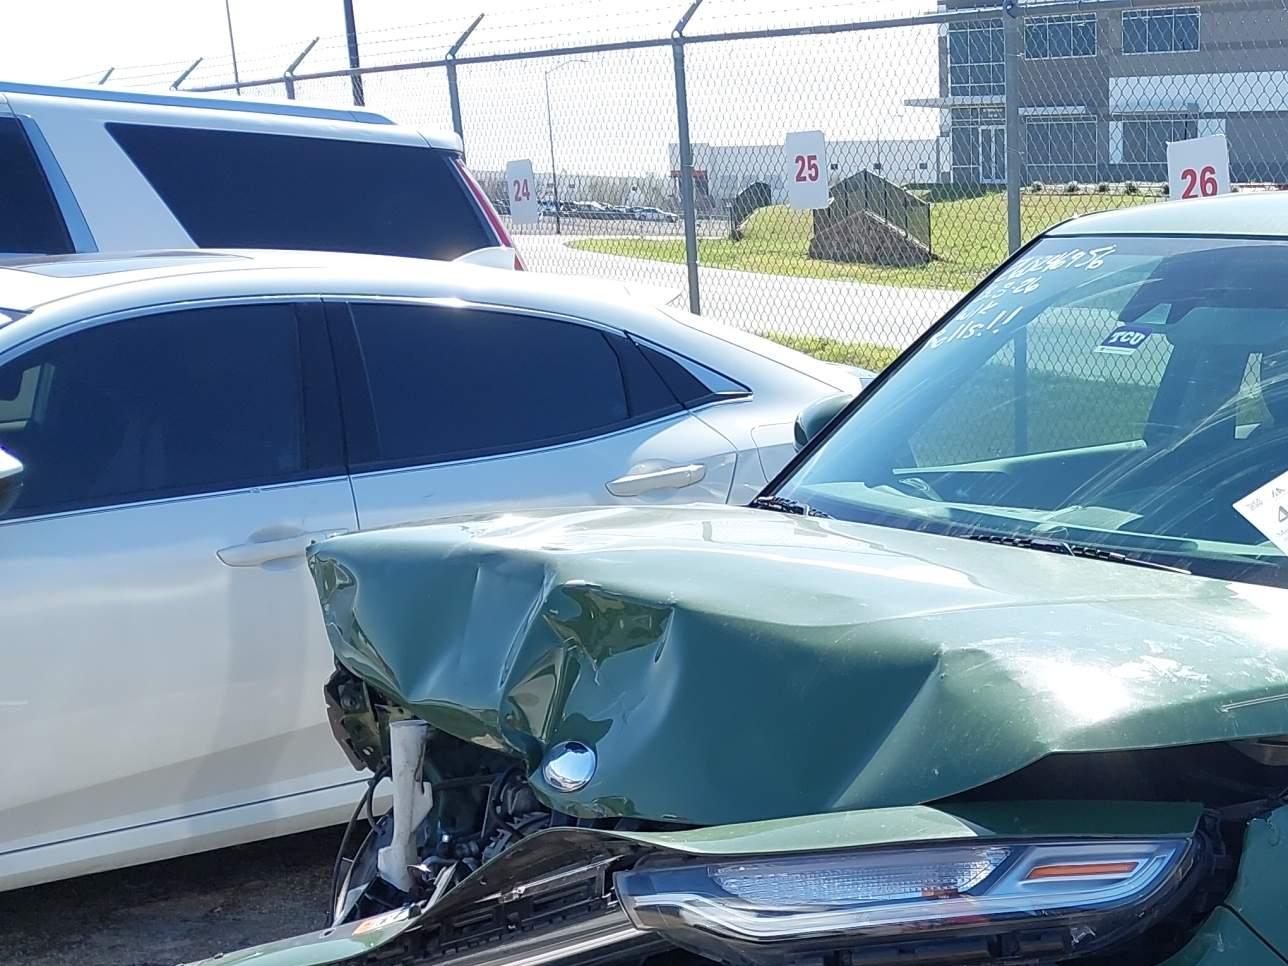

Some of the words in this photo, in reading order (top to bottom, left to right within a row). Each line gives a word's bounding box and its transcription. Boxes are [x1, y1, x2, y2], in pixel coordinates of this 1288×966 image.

[794, 155, 818, 181] 25
[513, 179, 530, 201] 24
[1181, 166, 1218, 199] 26
[1107, 330, 1147, 346] TCU
